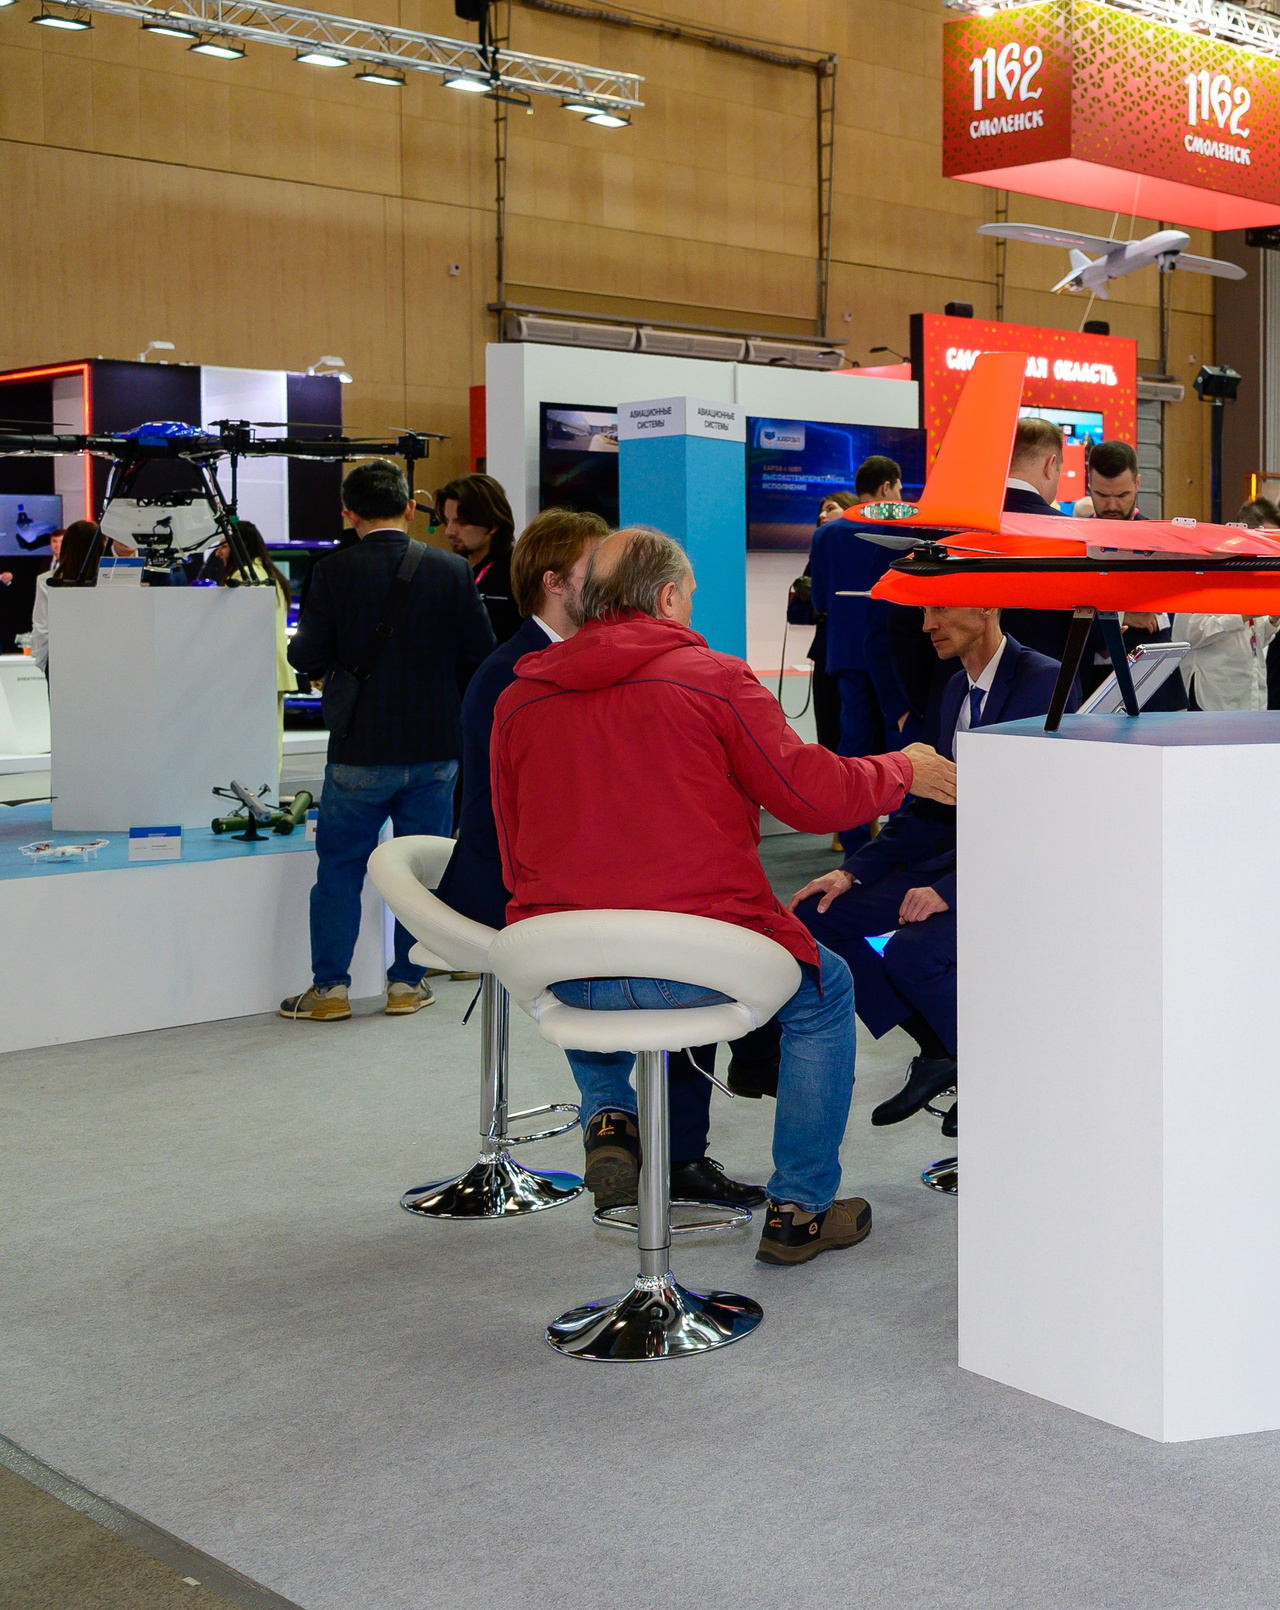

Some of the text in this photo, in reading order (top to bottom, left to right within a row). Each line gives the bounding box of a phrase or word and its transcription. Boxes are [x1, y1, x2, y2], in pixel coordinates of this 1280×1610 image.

[969, 42, 1043, 111] 1162
[1184, 69, 1251, 139] 1162
[970, 109, 1044, 139] СМОЛЕНСК
[1184, 134, 1251, 165] СМОЛЕНСК
[1053, 359, 1118, 385] ОБЛАСТЬ
[630, 406, 672, 418] АВИАЦИОННЫЕ
[637, 419, 665, 430] СИСТЕМЫ
[697, 407, 735, 421] АВИАЦИОННЫЕ
[704, 420, 729, 431] СИСТЕМЫ
